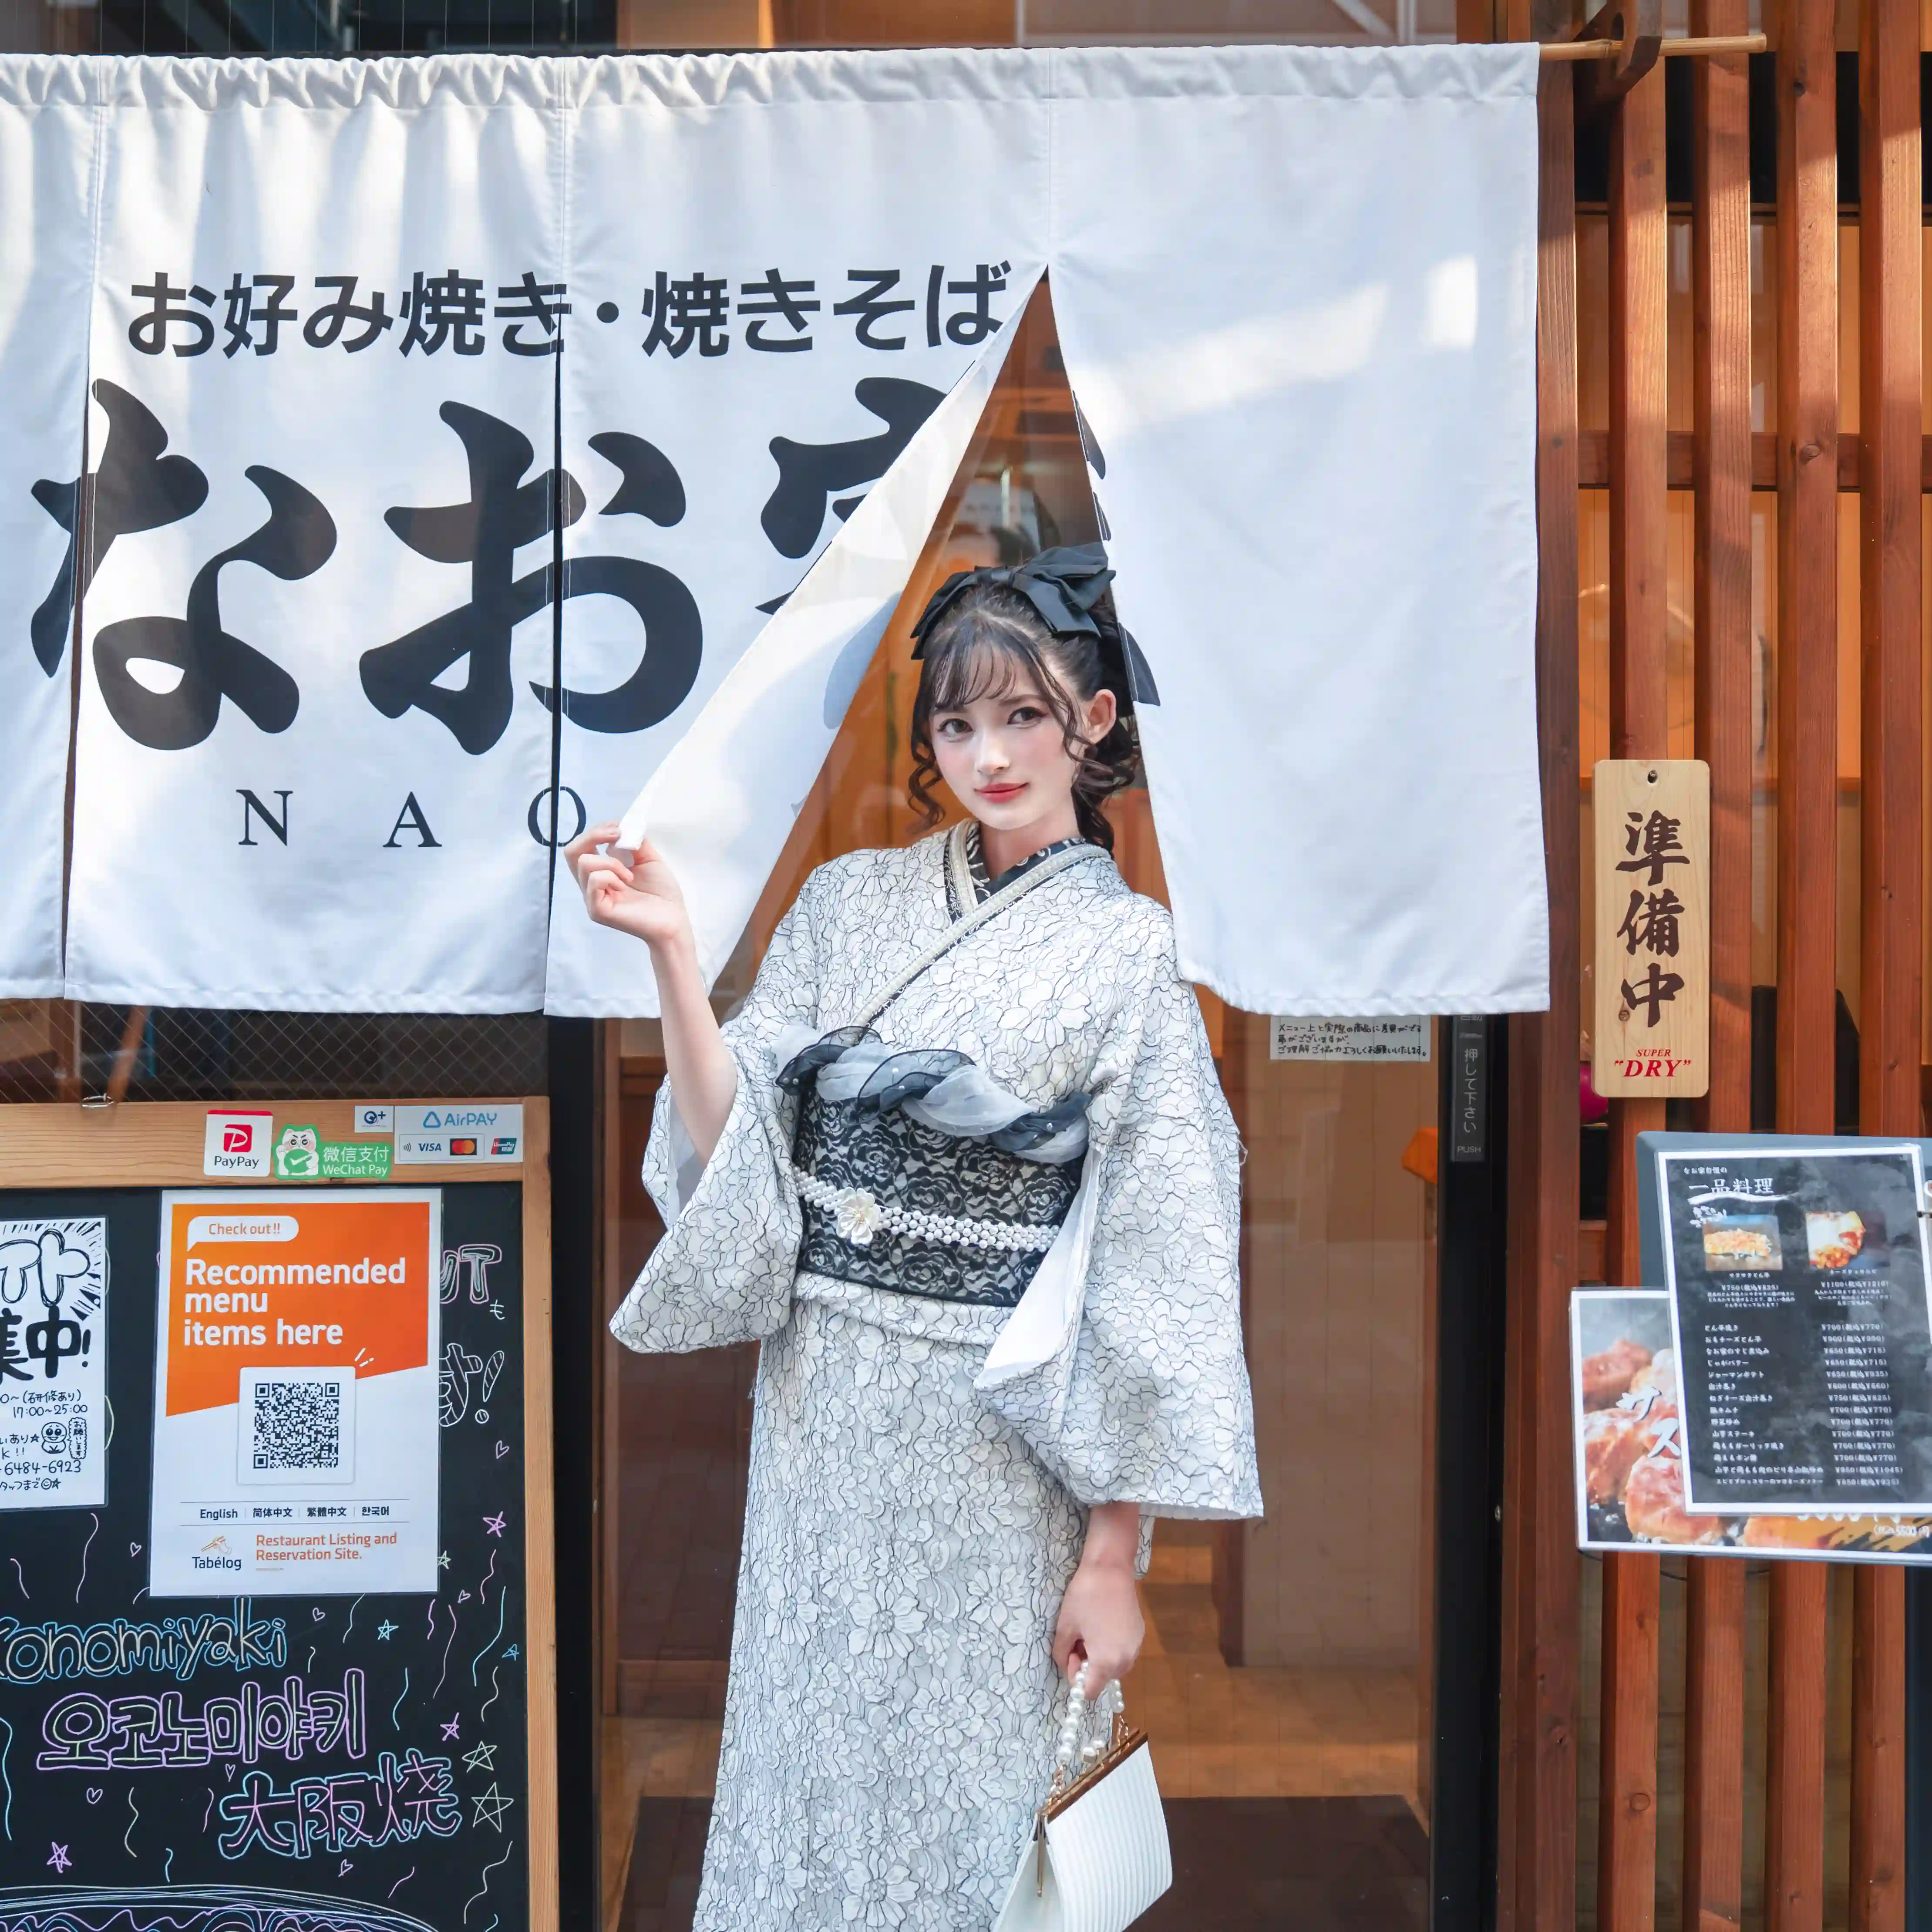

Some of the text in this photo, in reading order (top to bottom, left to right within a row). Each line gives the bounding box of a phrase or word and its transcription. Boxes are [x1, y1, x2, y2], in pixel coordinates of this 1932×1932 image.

[127, 260, 1012, 359] お好み焼き・焼きそば
[1615, 809, 1690, 1028] 準備中
[1636, 1049, 1671, 1057] SUPER
[1464, 1048, 1478, 1133] 押して下さい
[323, 1145, 389, 1163] 微信支付
[417, 1142, 442, 1152] VISA
[214, 1155, 259, 1169] PayPay
[323, 1164, 388, 1177] WeChat Pay
[1688, 1177, 1775, 1195] 一品料理
[209, 1222, 247, 1235] Check
[185, 1257, 406, 1286] Recommended
[184, 1292, 269, 1313] menu
[183, 1318, 343, 1346] items here
[199, 1508, 238, 1520] English
[252, 1507, 293, 1518] 简体中文
[306, 1506, 347, 1518] 繁體中文
[361, 1506, 390, 1516] 한국어
[256, 1532, 397, 1548] Restaurant Listing and
[256, 1548, 362, 1561] Reservation Site.
[192, 1556, 242, 1571] Tabélog
[36, 1668, 366, 1770] 오코노미야키
[218, 1747, 462, 1859] 大阪烧
